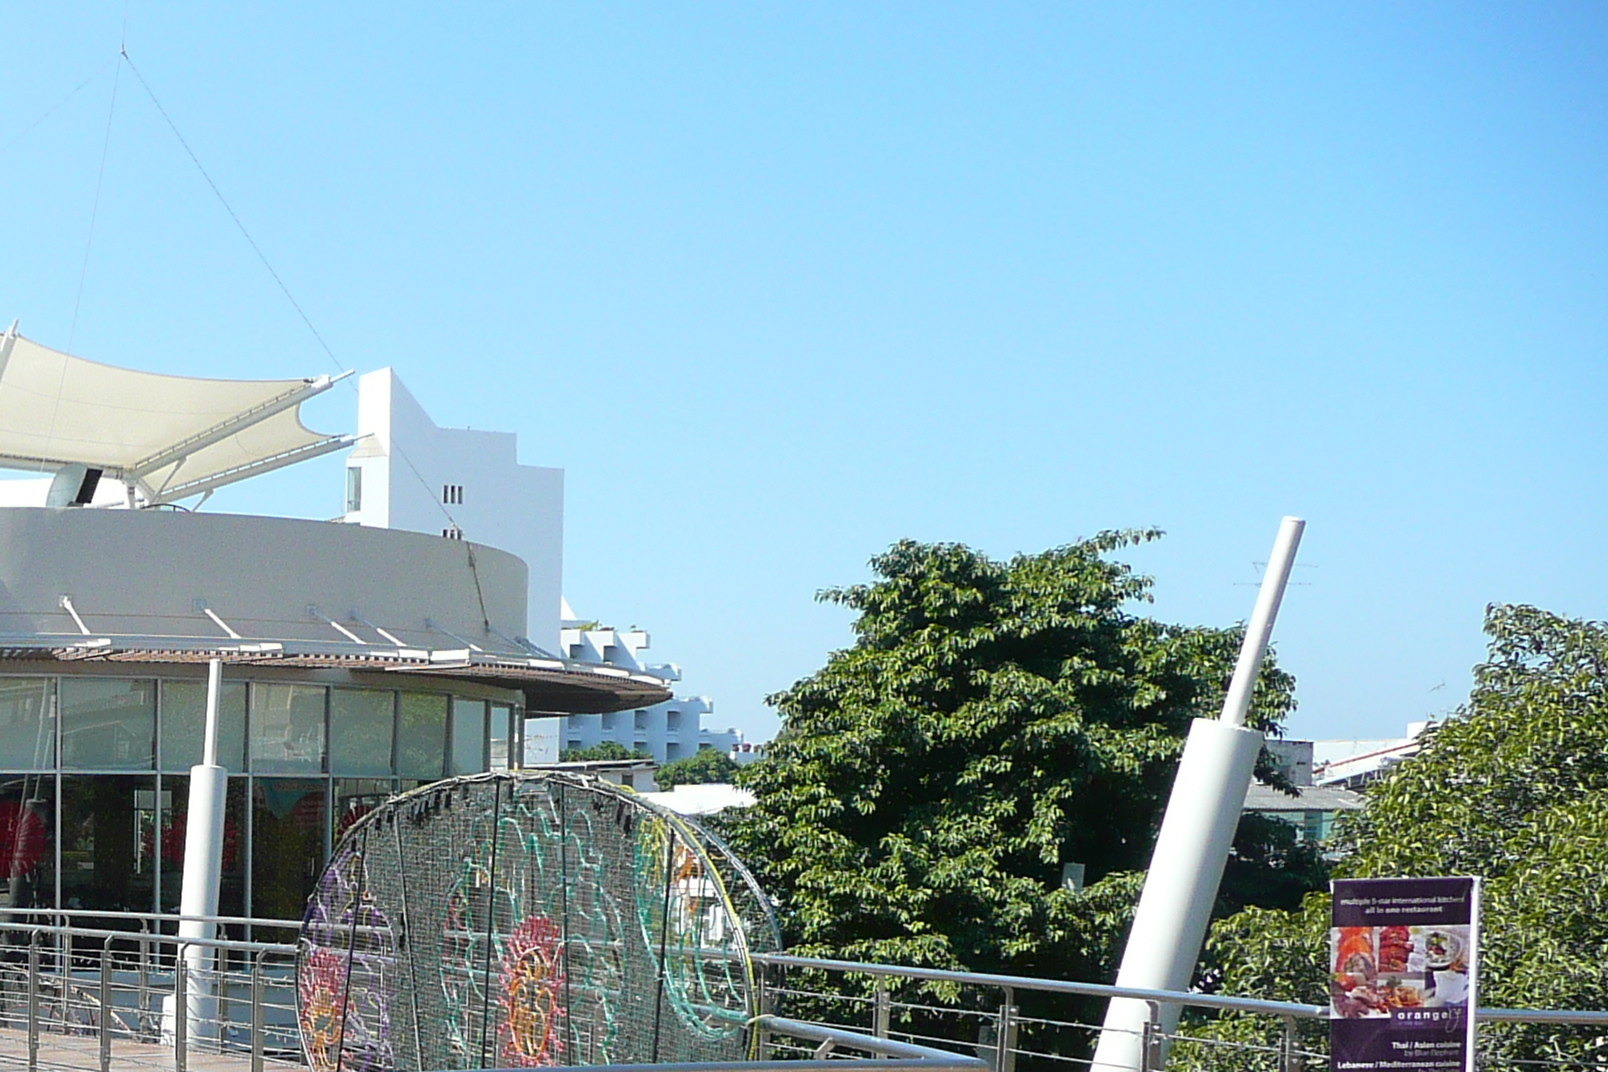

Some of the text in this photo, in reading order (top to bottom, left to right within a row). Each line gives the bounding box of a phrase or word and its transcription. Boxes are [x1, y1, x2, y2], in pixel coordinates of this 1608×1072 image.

[1392, 896, 1436, 904] international
[1392, 1041, 1409, 1049] Thai
[1337, 1061, 1374, 1069] Lebanese
[1380, 1060, 1434, 1068] Mediterranean
